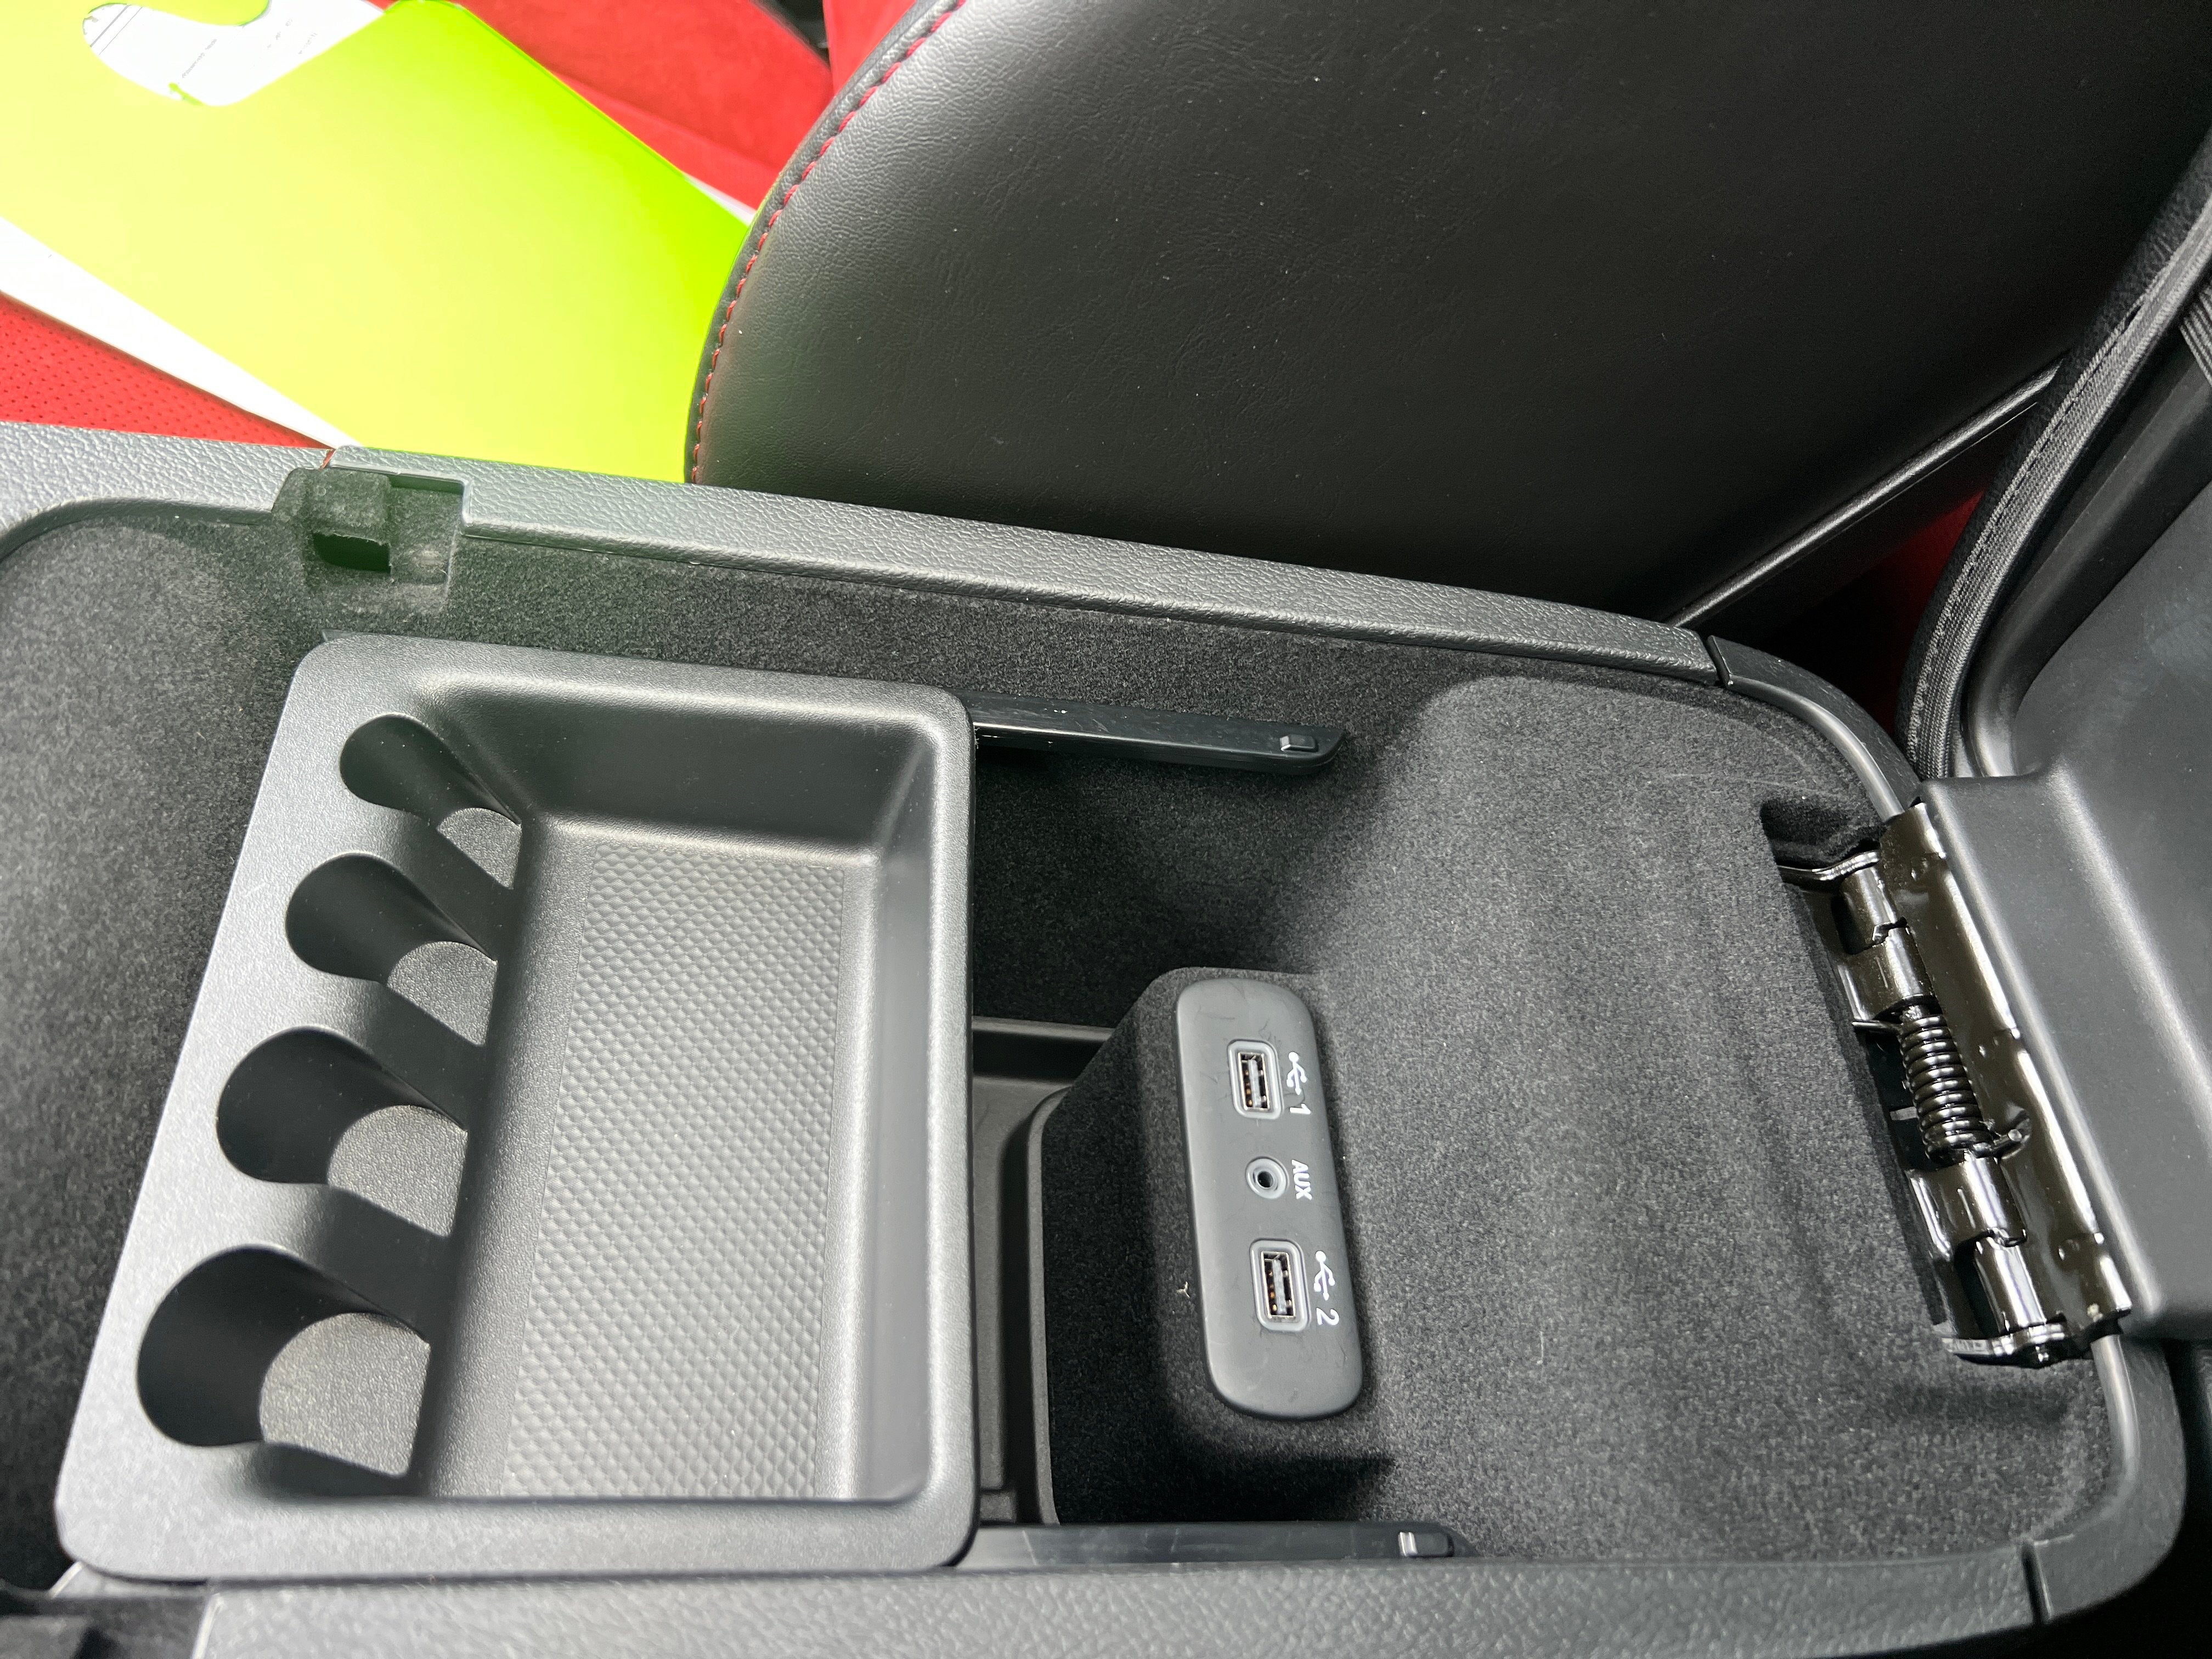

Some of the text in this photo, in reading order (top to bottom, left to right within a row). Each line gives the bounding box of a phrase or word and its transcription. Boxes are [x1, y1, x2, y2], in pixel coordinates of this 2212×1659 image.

[1289, 1103, 1311, 1115] 1
[1291, 1159, 1313, 1200] AUX
[1316, 1307, 1340, 1325] 2
